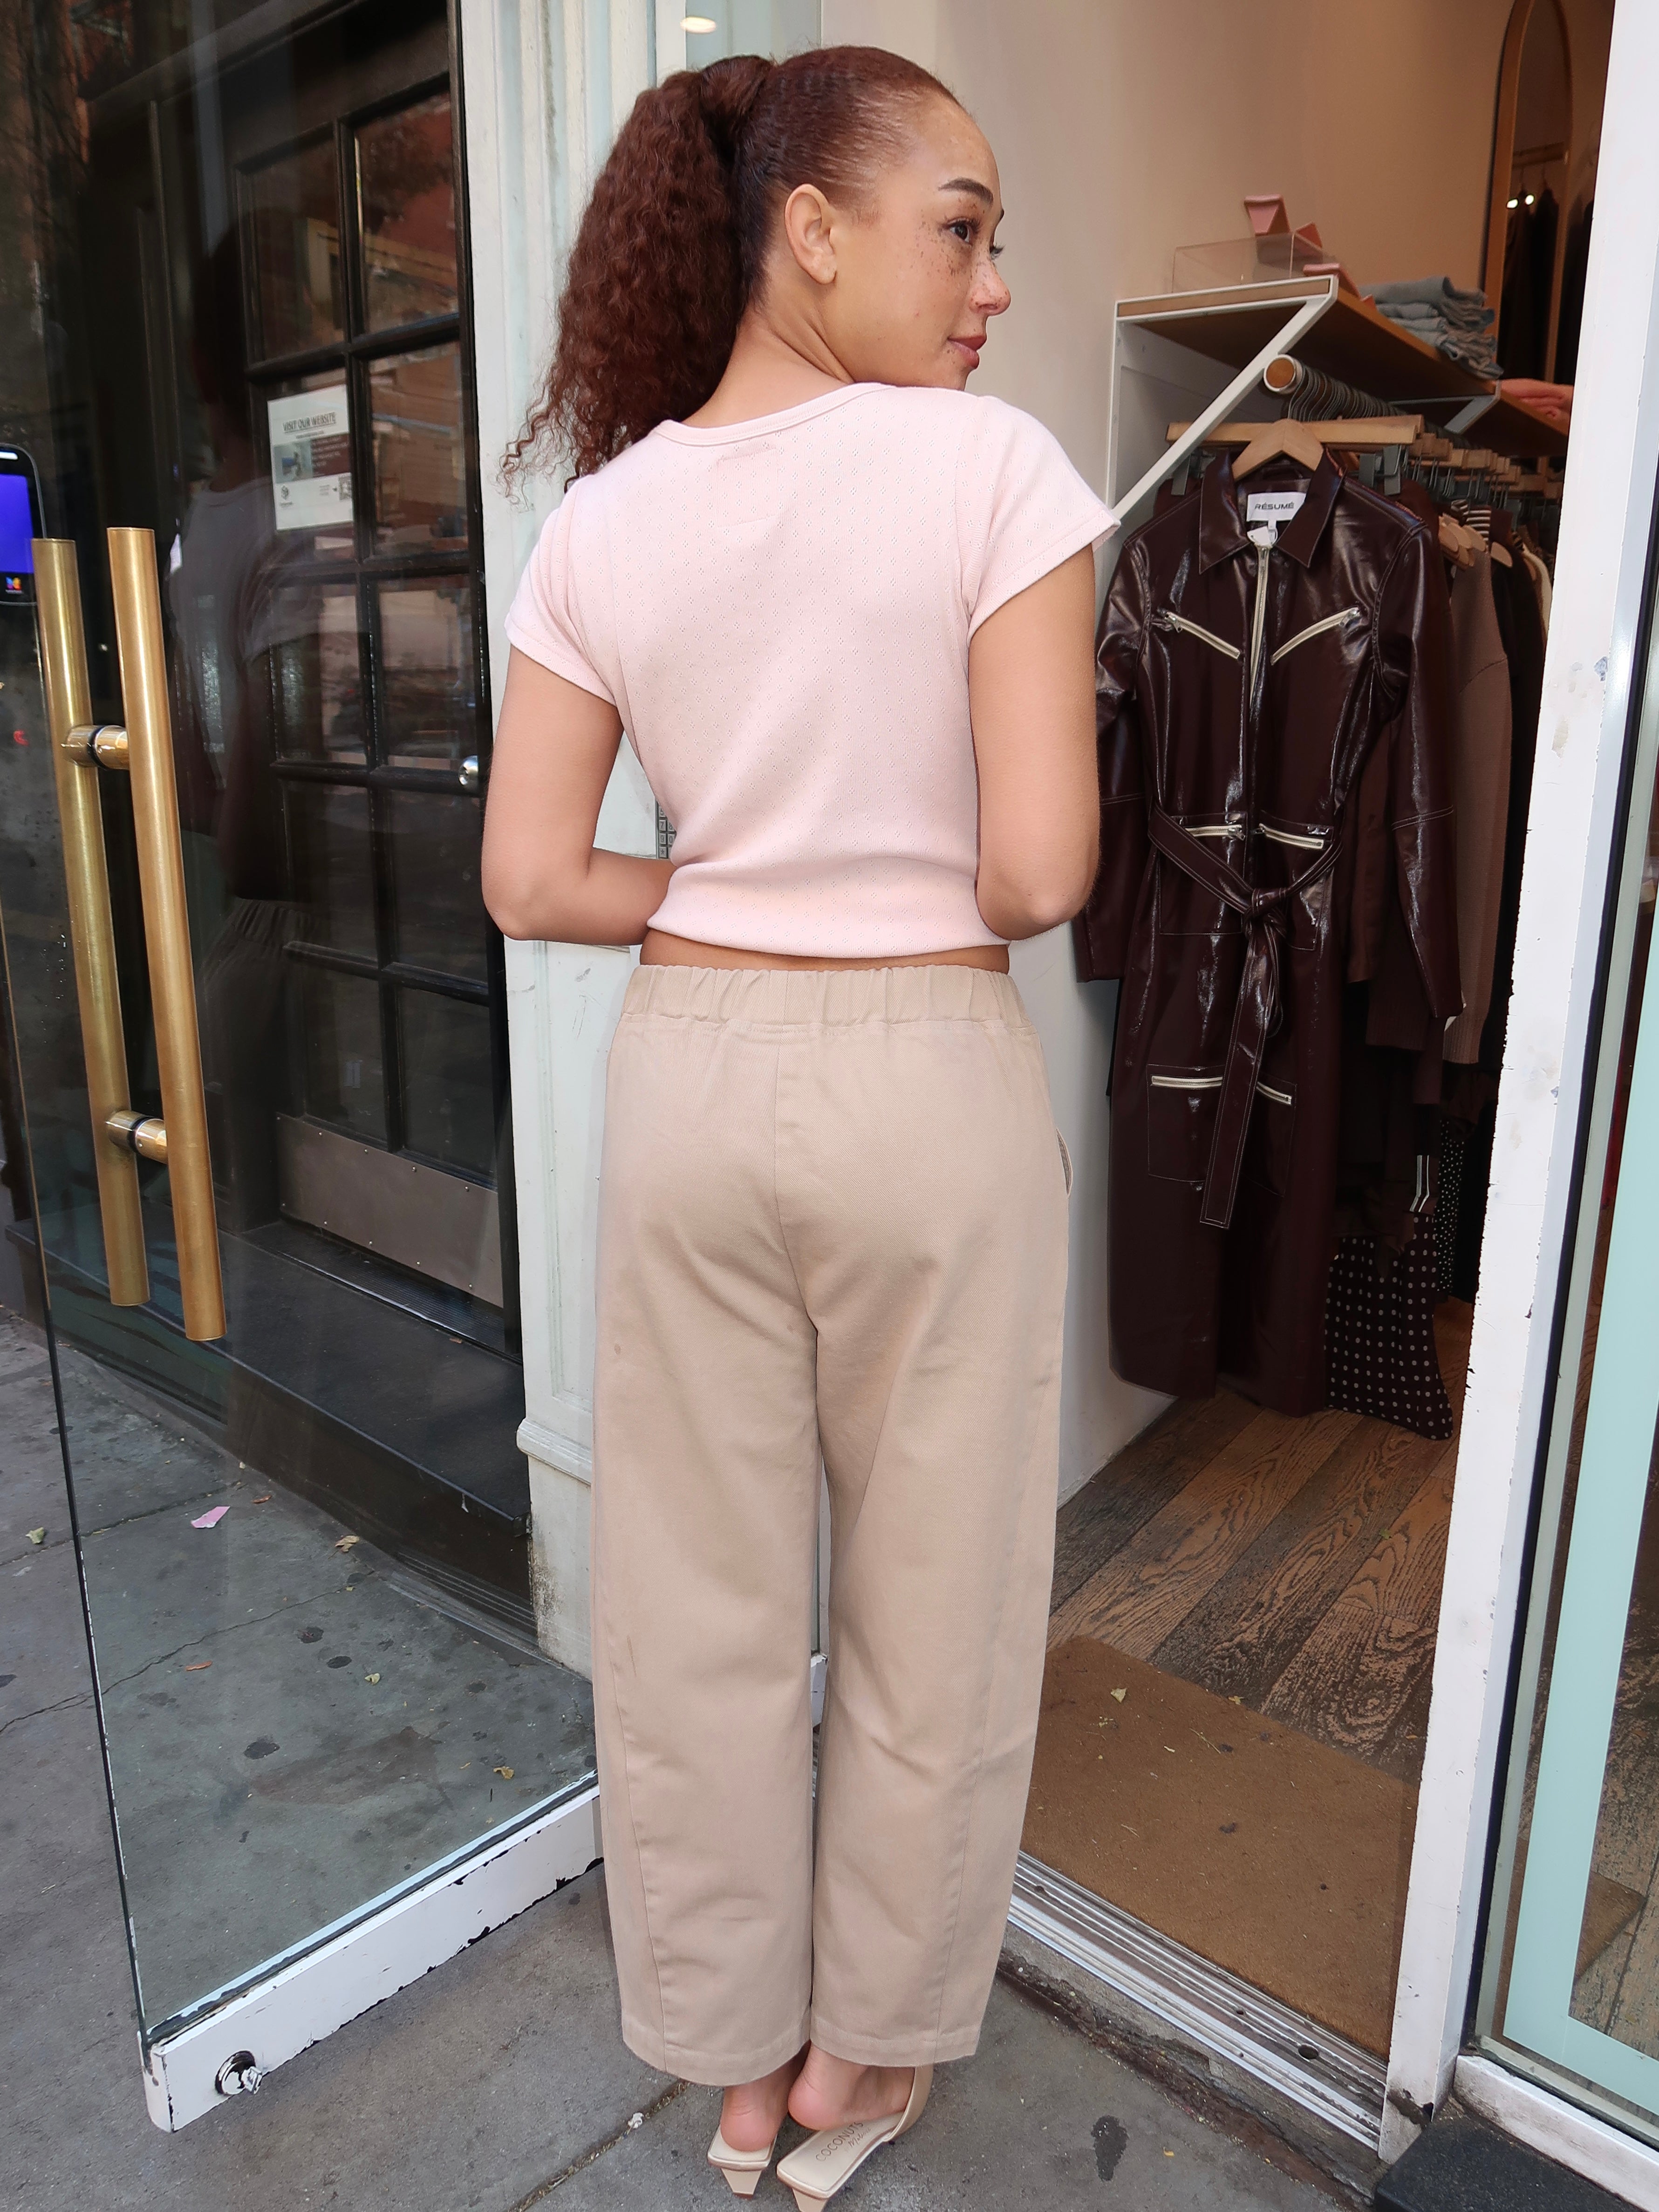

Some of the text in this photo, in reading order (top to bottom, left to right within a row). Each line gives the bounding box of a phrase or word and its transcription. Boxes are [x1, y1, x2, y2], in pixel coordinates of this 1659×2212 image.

[283, 412, 336, 431] VISIT OUR WEBSITE
[1254, 501, 1295, 510] RÉSUMÉ
[816, 2122, 863, 2161] COCONUTS
